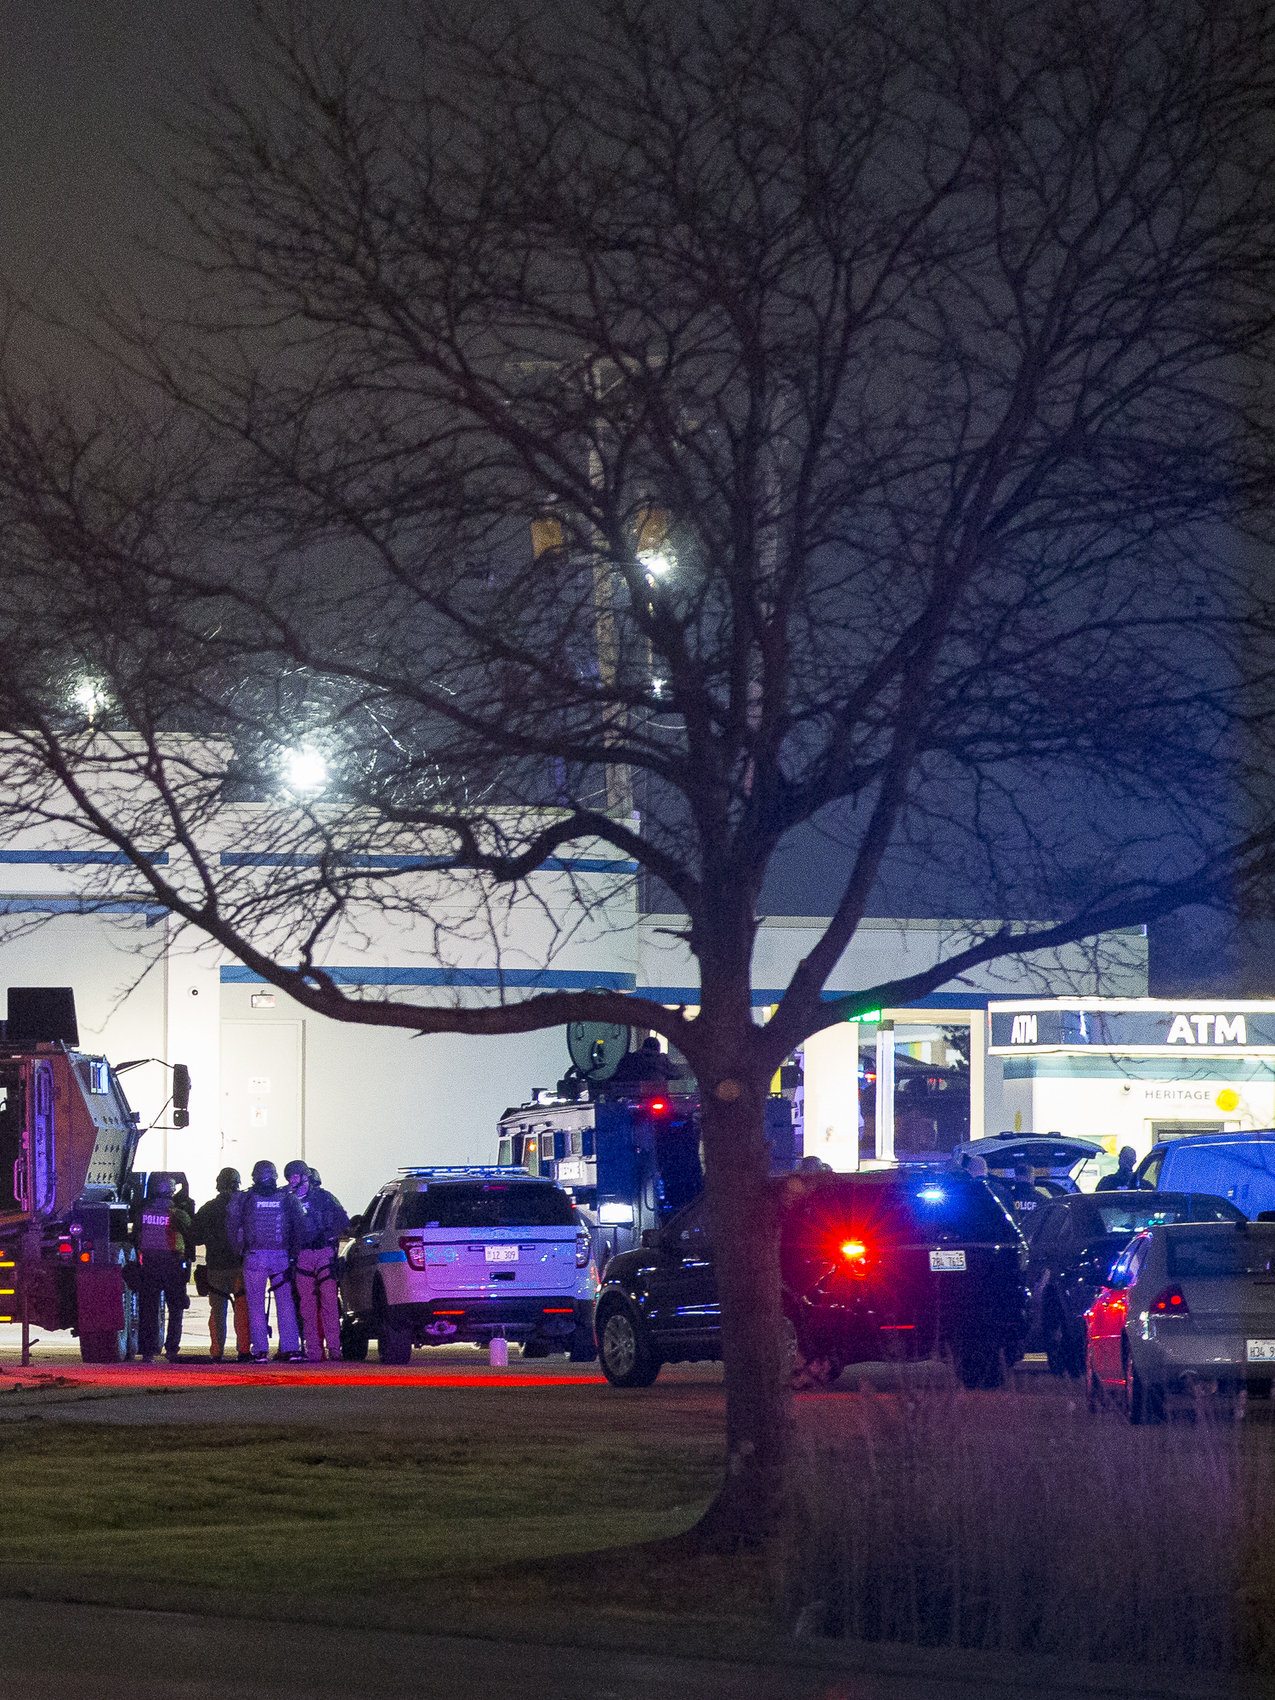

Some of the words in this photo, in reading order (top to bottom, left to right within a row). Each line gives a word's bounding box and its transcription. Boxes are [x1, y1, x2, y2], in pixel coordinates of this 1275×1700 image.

[1010, 1014, 1038, 1044] ATM
[1166, 1014, 1247, 1044] ATM
[1145, 1089, 1211, 1100] HERITAGE
[142, 1214, 170, 1226] POLICE
[425, 1247, 456, 1263] K-9
